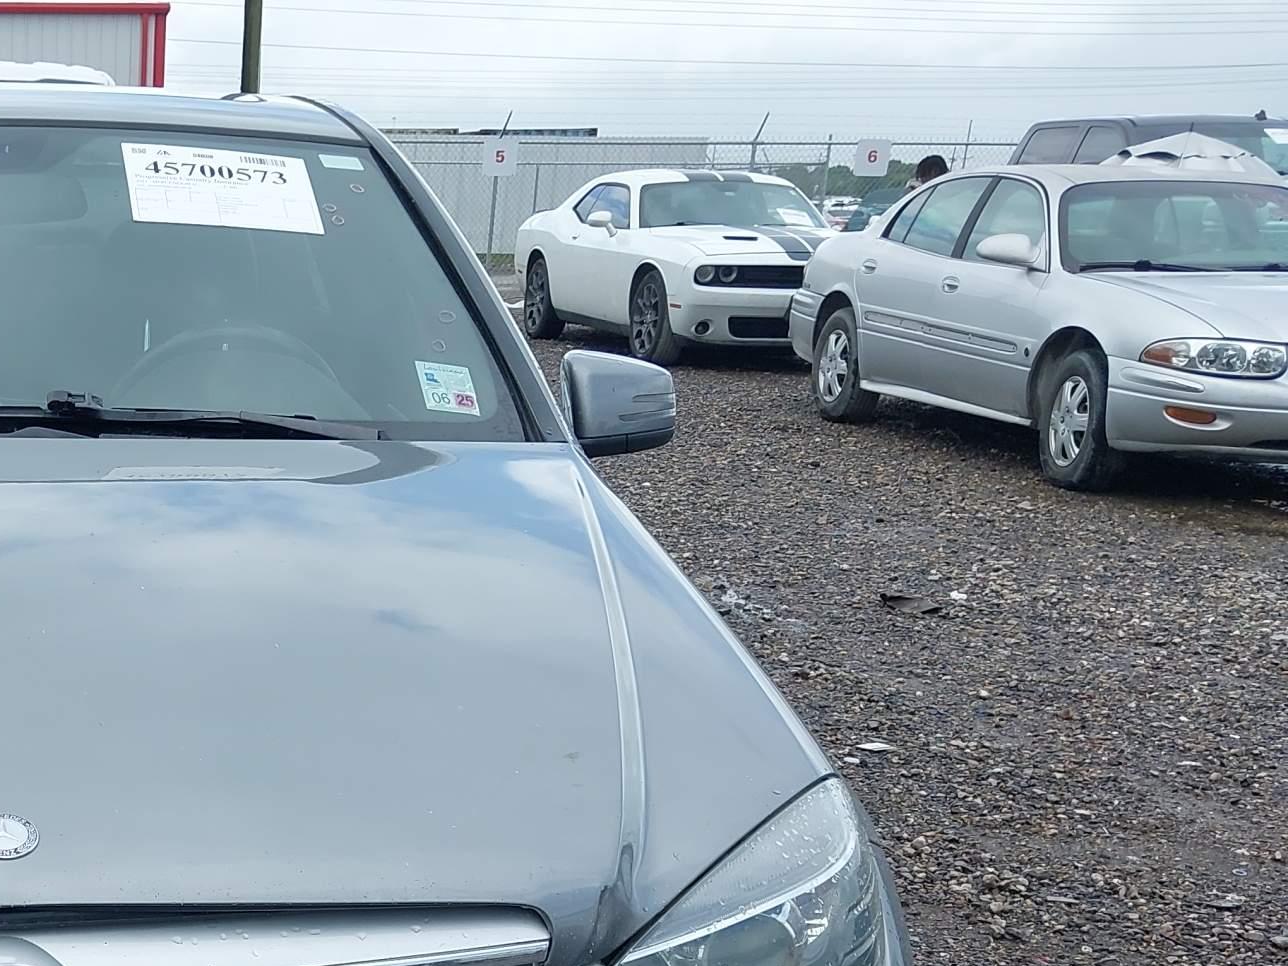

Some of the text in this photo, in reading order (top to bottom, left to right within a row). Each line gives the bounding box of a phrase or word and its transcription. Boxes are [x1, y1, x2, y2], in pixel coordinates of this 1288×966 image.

[495, 150, 505, 163] 5
[868, 150, 878, 163] 6
[144, 160, 288, 185] 45700573
[431, 391, 474, 408] 06 25
